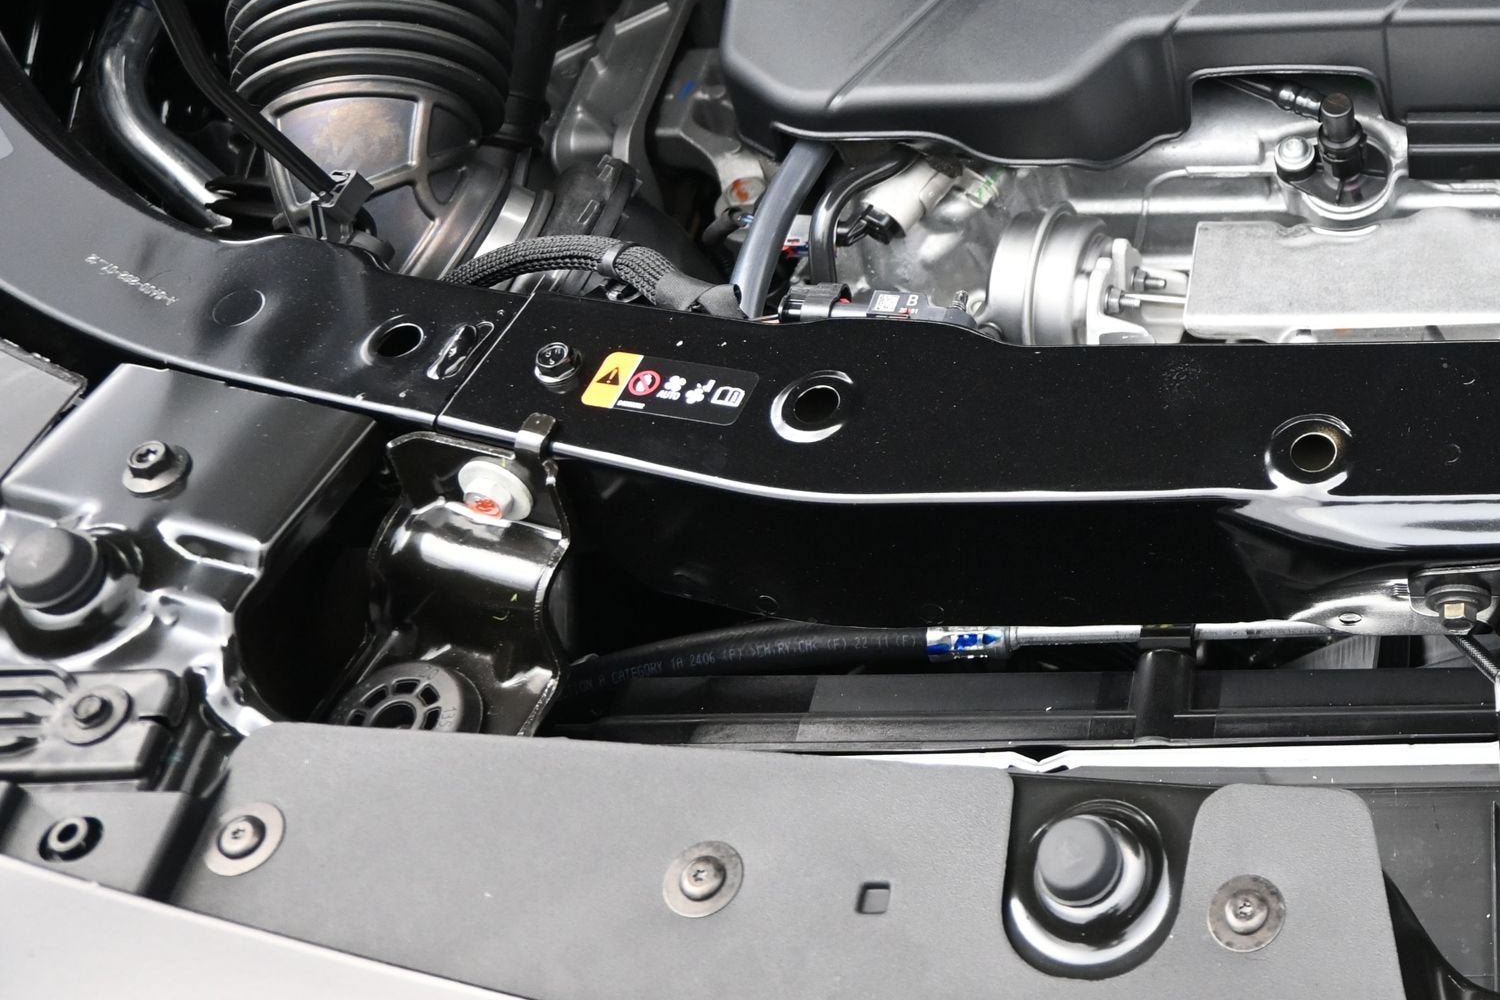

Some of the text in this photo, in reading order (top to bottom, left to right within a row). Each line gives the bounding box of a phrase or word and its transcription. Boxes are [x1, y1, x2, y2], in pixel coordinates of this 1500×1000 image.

[656, 389, 681, 401] AUTO
[610, 661, 663, 685] CATEGORY
[689, 653, 716, 669] 2406
